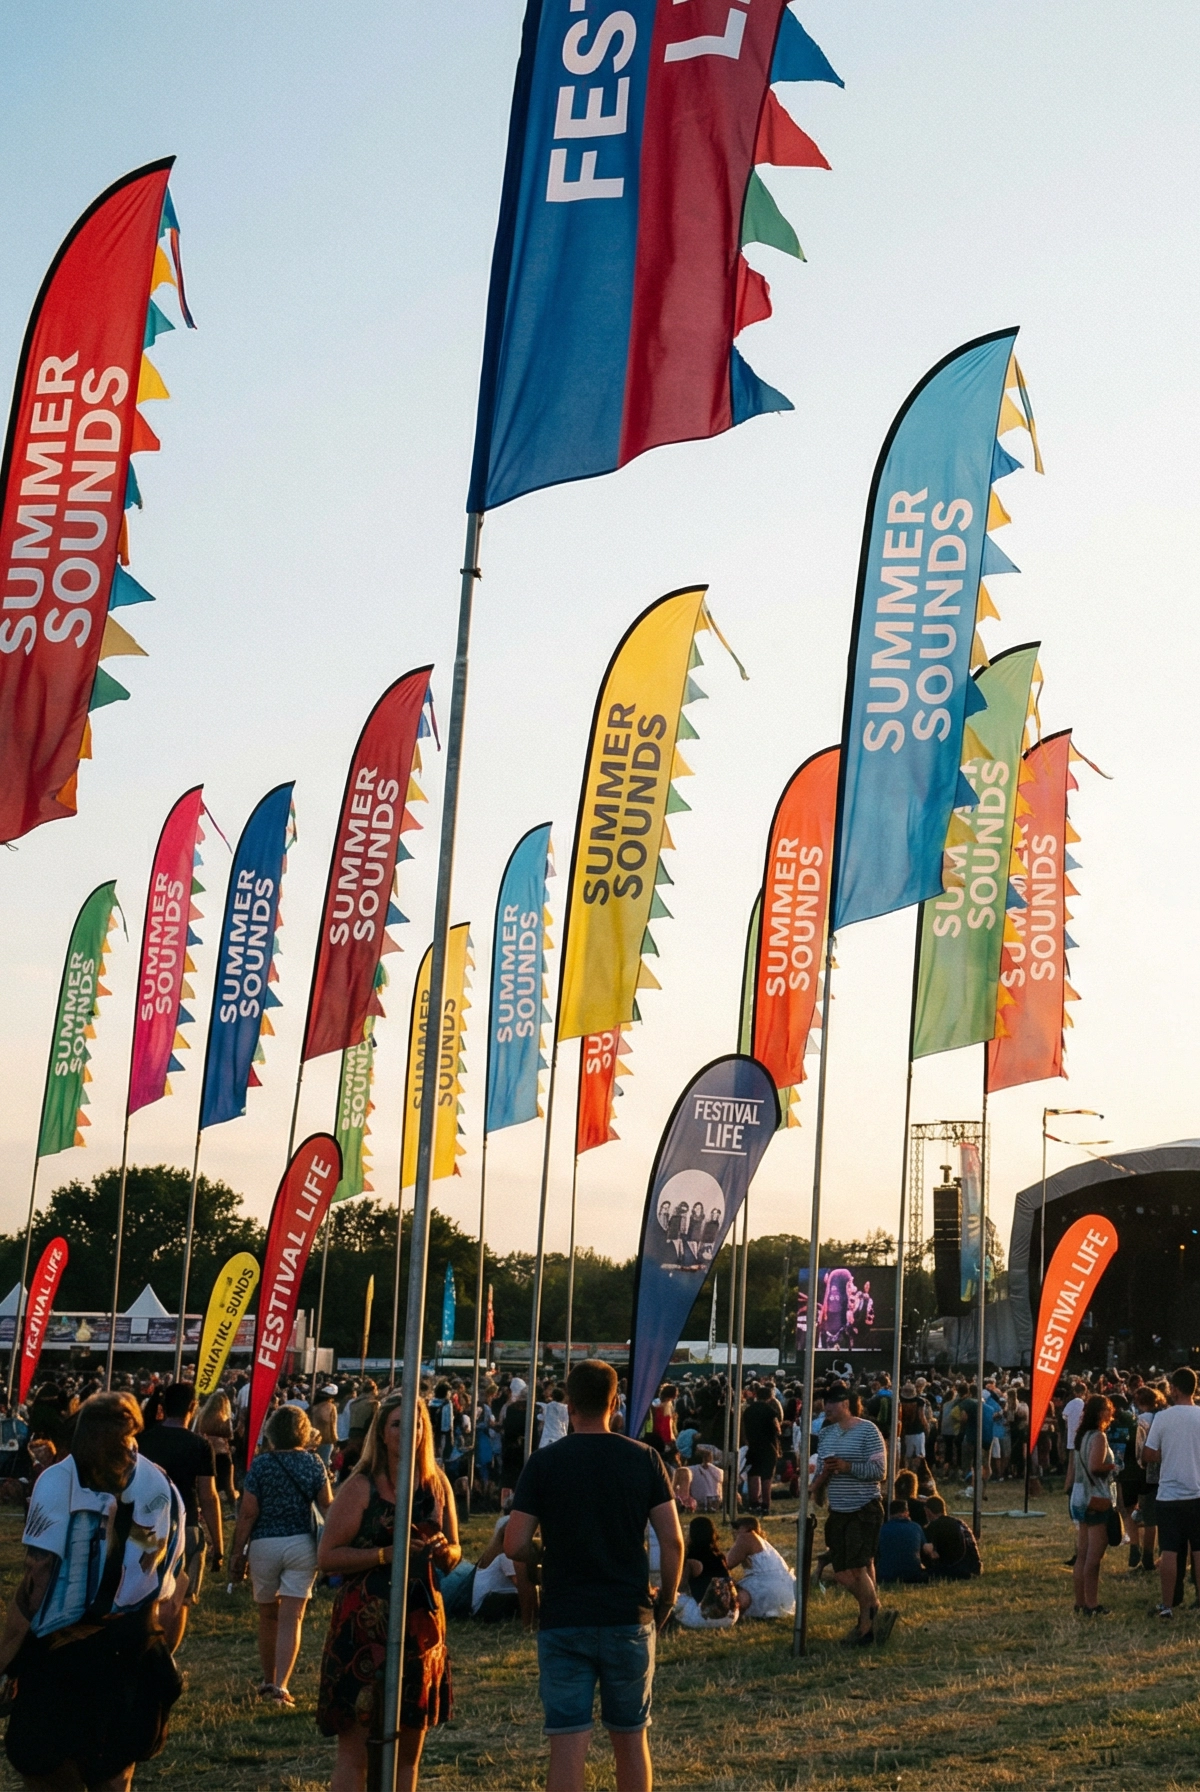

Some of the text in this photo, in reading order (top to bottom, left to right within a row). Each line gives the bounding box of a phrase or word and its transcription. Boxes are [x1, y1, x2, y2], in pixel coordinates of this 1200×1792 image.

[546, 0, 637, 202] FES
[0, 350, 80, 656] SUMMER
[43, 364, 129, 649] SOUNDS
[862, 486, 930, 755] SUMMER
[912, 498, 973, 743] SOUNDS
[328, 766, 379, 947] SUMMER
[352, 777, 400, 942] SOUNDS
[583, 701, 637, 906] SUMMER
[613, 713, 667, 901] SOUNDS
[967, 760, 1010, 930] SOUNDS
[141, 872, 170, 1021] SUMMER
[155, 880, 184, 1015] SOUNDS
[220, 868, 256, 1024] SUMMER
[239, 876, 274, 1019] SOUNDS
[496, 902, 520, 1043] SUMMER
[515, 910, 538, 1038] SOUNDS
[765, 837, 802, 997] SUMMER
[788, 846, 824, 992] SOUNDS
[1030, 834, 1057, 981] SOUNDS
[55, 951, 84, 1077] SUMMER
[70, 958, 95, 1074] SOUNDS
[438, 998, 456, 1107] SOUNDS
[694, 1100, 761, 1126] FESTIVAL
[704, 1123, 745, 1150] LIFE
[226, 1268, 254, 1317] SUNDS
[258, 1155, 332, 1371] FESTIVAL LIFE
[1036, 1228, 1109, 1375] FESTIVAL LIFE
